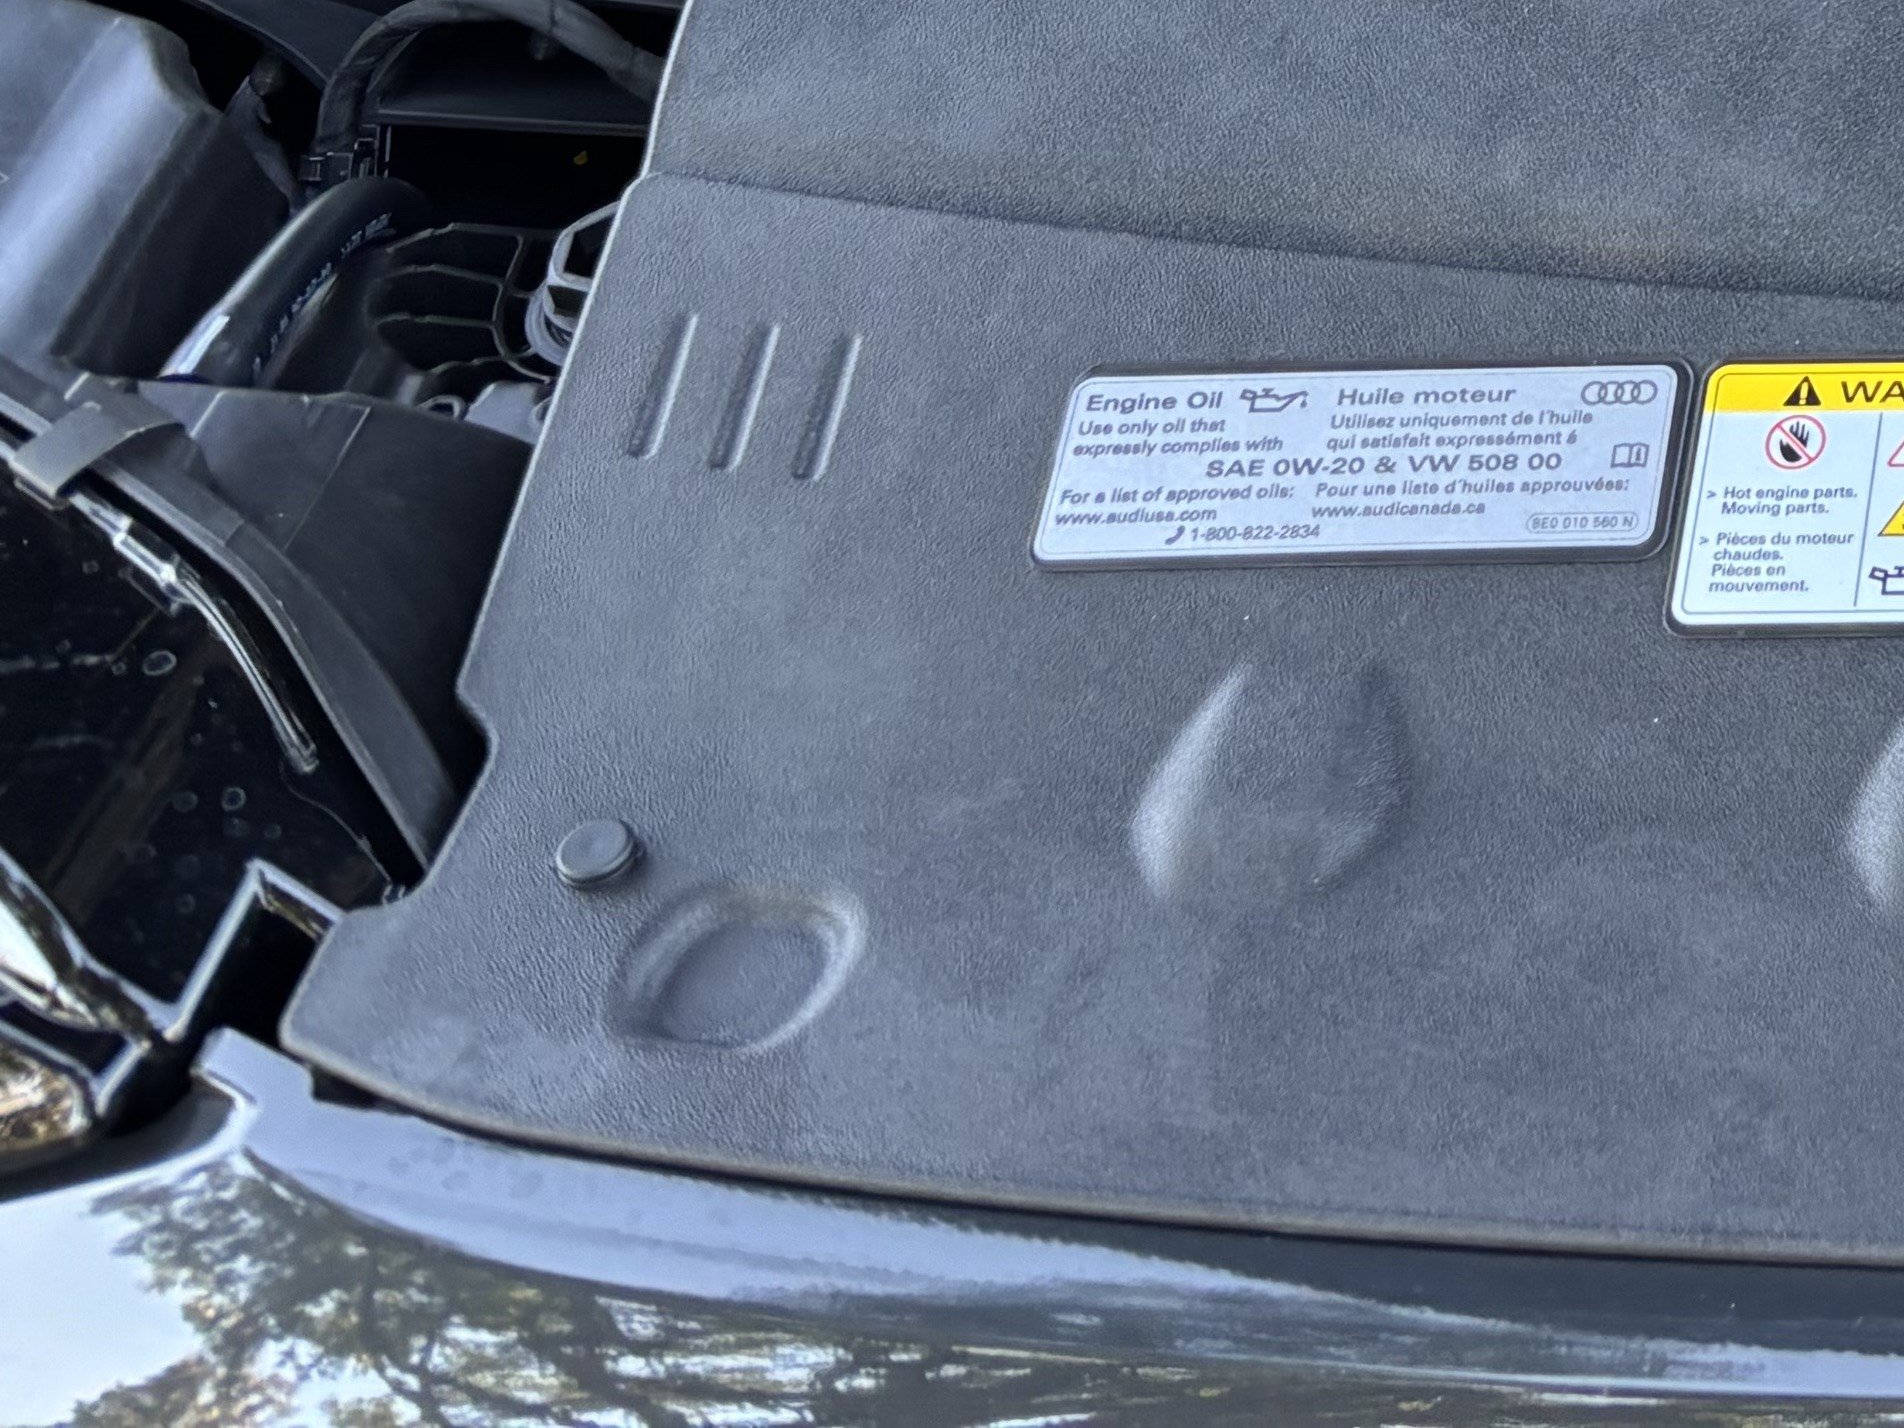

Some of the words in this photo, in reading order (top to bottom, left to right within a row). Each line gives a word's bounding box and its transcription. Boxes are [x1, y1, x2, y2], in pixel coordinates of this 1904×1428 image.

[1086, 392, 1177, 414] Engine
[1187, 391, 1223, 410] Oil
[1337, 388, 1404, 406] Huile
[1414, 387, 1517, 405] moteur
[1078, 420, 1113, 436] Use
[1117, 420, 1158, 437] only
[1162, 419, 1186, 434] oil
[1190, 417, 1226, 434] that
[1330, 413, 1395, 430] Utilisez
[1399, 410, 1507, 431] uniquement
[1512, 409, 1534, 426] de
[1073, 441, 1154, 459] expressly
[1160, 438, 1240, 456] complies
[1245, 436, 1284, 452] with
[1326, 434, 1355, 451] qui
[1360, 431, 1431, 450] satisfait
[1435, 429, 1561, 450] expressément
[1205, 459, 1266, 478] SAE
[1273, 456, 1364, 477] 0W-20
[1374, 456, 1396, 475] &
[1408, 453, 1461, 473] VW
[1467, 453, 1518, 472] 508
[1527, 452, 1563, 471] 00
[1059, 489, 1090, 505] For
[1094, 492, 1106, 505] a
[1110, 487, 1139, 503] list
[1142, 486, 1163, 502] of
[1166, 485, 1251, 505] approved
[1315, 482, 1358, 498] Pour
[1363, 482, 1396, 497] une
[1401, 480, 1439, 496] liste
[1724, 486, 1751, 499] Hot
[1755, 485, 1809, 501] engine
[1813, 486, 1858, 501] parts.
[1055, 508, 1218, 526] www.audiusa.com
[1311, 501, 1485, 518] www.audicanada.ca
[1721, 501, 1780, 516] Moving
[1785, 502, 1829, 516] parts.
[1563, 516, 1589, 529] 010
[1190, 524, 1321, 542] 1-800-822-2834
[1716, 532, 1766, 546] Pièces
[1770, 531, 1791, 544] du
[1796, 532, 1855, 544] moteur
[1713, 548, 1783, 561] chaudes.
[1711, 563, 1761, 577] Pièces
[1766, 565, 1786, 576] en
[1708, 579, 1809, 592] mouvement.
